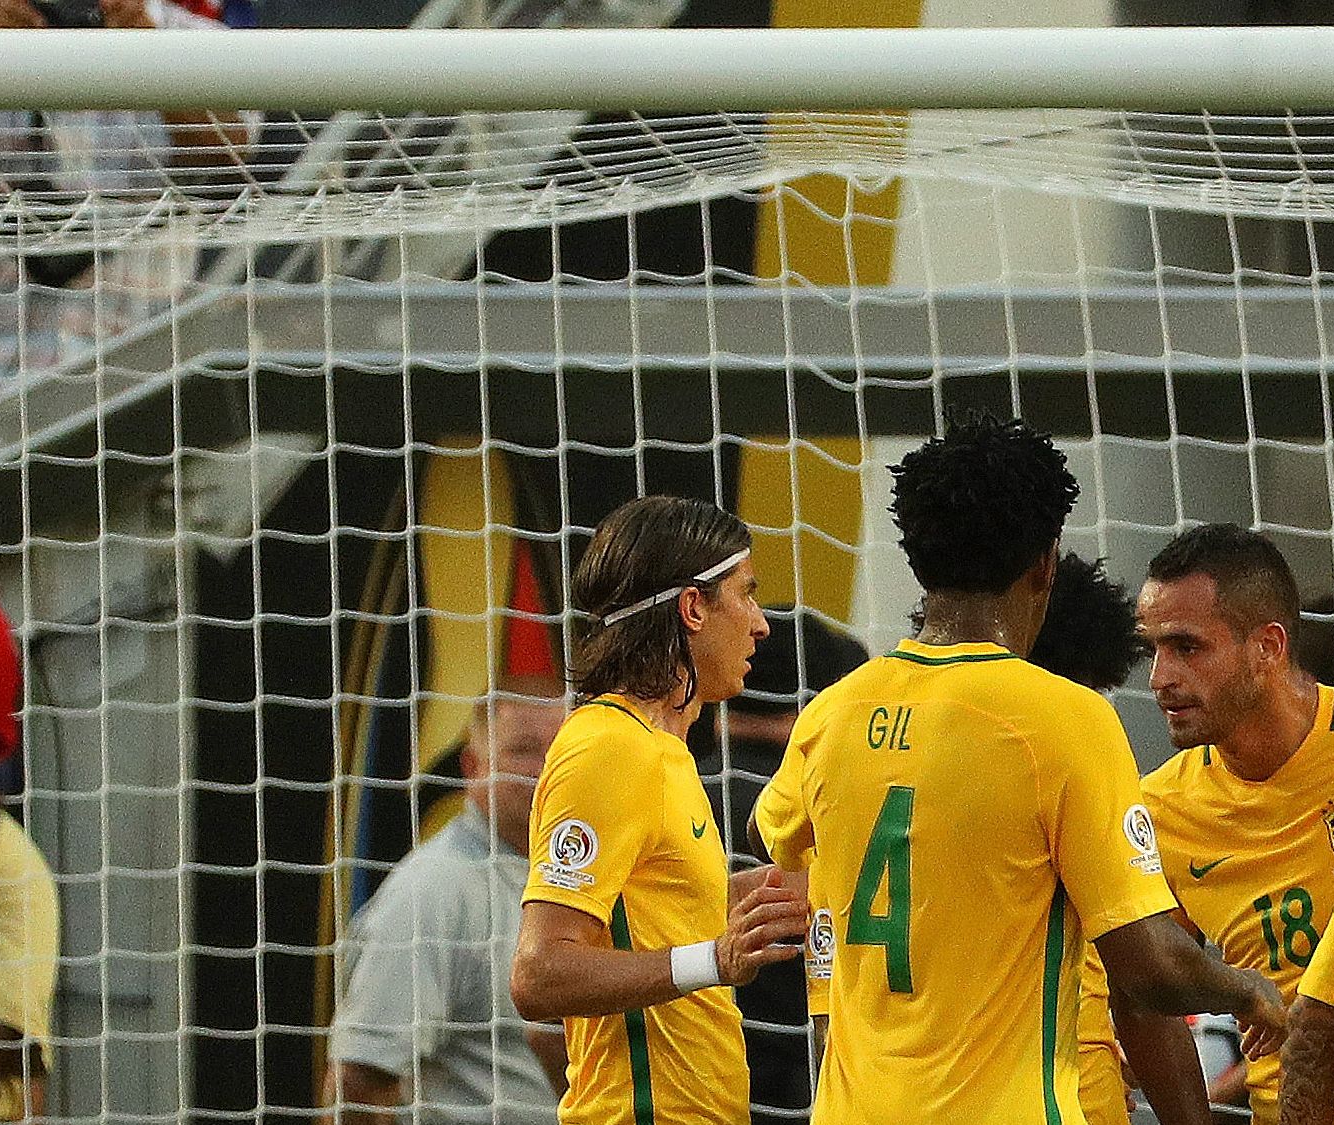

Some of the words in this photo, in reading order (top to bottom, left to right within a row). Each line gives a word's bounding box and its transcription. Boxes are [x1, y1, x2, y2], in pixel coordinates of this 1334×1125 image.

[867, 705, 912, 750] GIL
[846, 785, 915, 993] 4
[1254, 885, 1322, 972] 18
